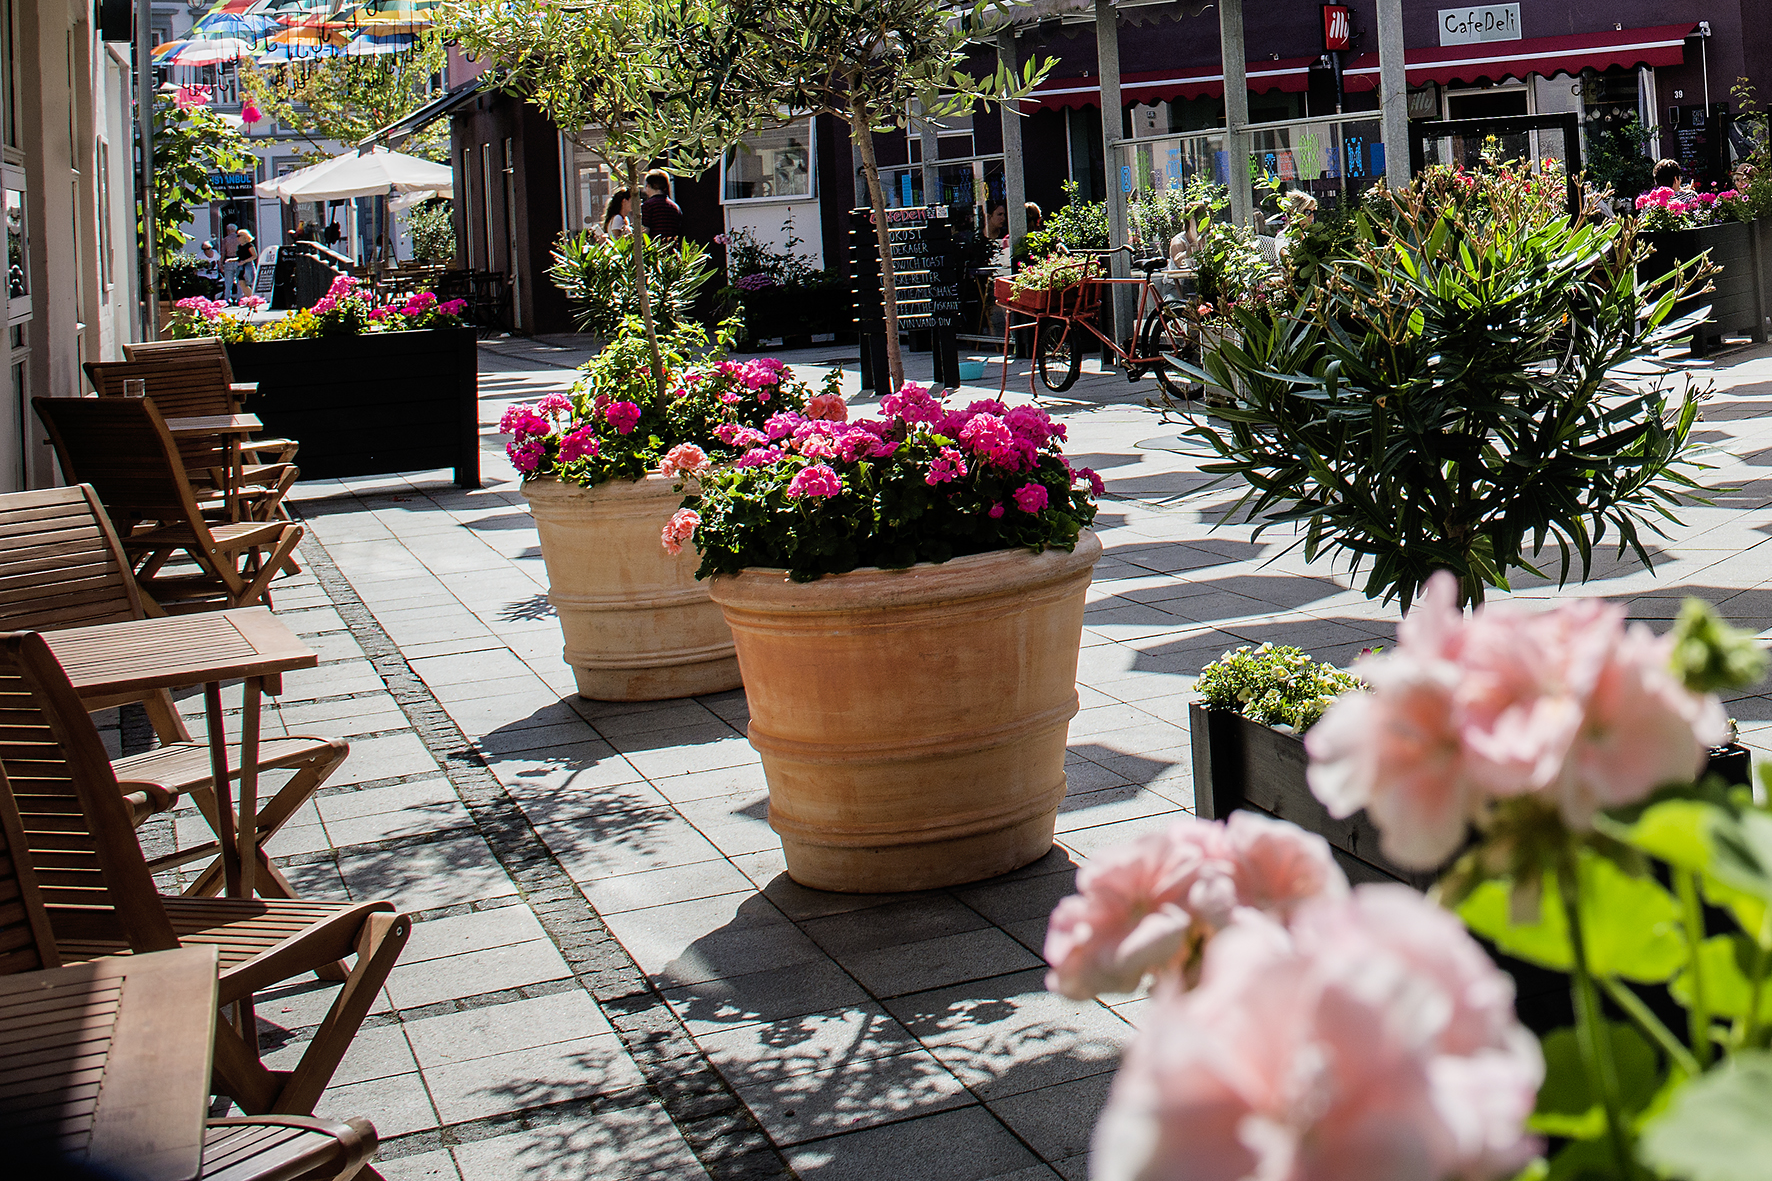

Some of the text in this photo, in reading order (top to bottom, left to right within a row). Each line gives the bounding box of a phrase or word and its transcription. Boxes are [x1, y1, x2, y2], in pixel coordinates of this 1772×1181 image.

[1329, 11, 1350, 45] illy
[1445, 9, 1515, 38] CafeDeli
[1674, 90, 1683, 99] 39
[1411, 93, 1433, 111] illy
[889, 229, 922, 242] OKOST
[891, 243, 928, 255] DEKAGER
[921, 256, 945, 268] TOAST
